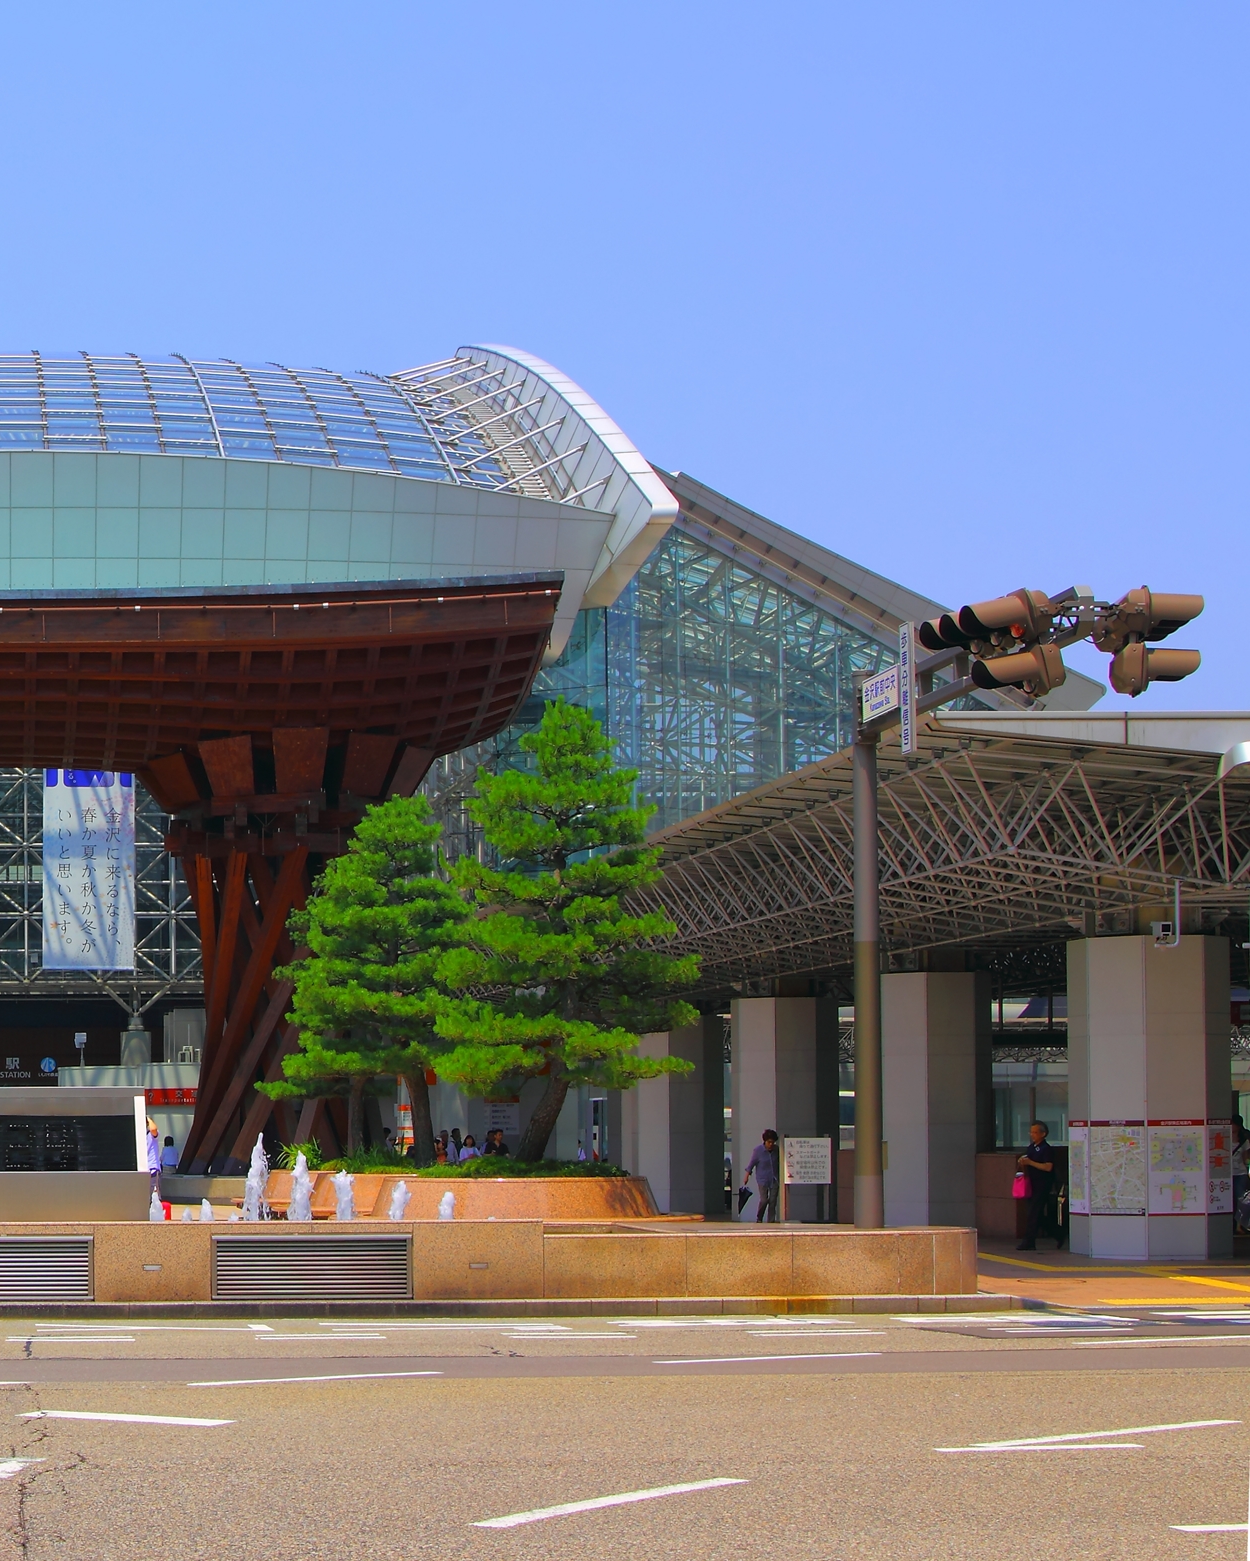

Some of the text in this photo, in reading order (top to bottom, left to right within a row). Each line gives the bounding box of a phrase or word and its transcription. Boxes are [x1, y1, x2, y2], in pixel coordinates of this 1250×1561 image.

[865, 674, 895, 703] 金沢駅前中央
[901, 632, 909, 745] 歩車分離信号
[57, 808, 72, 945] いいと思います。
[81, 807, 97, 953] 春か夏か秋か冬が
[105, 807, 121, 946] 金沢に来るなら、
[0, 1071, 31, 1079] STATION
